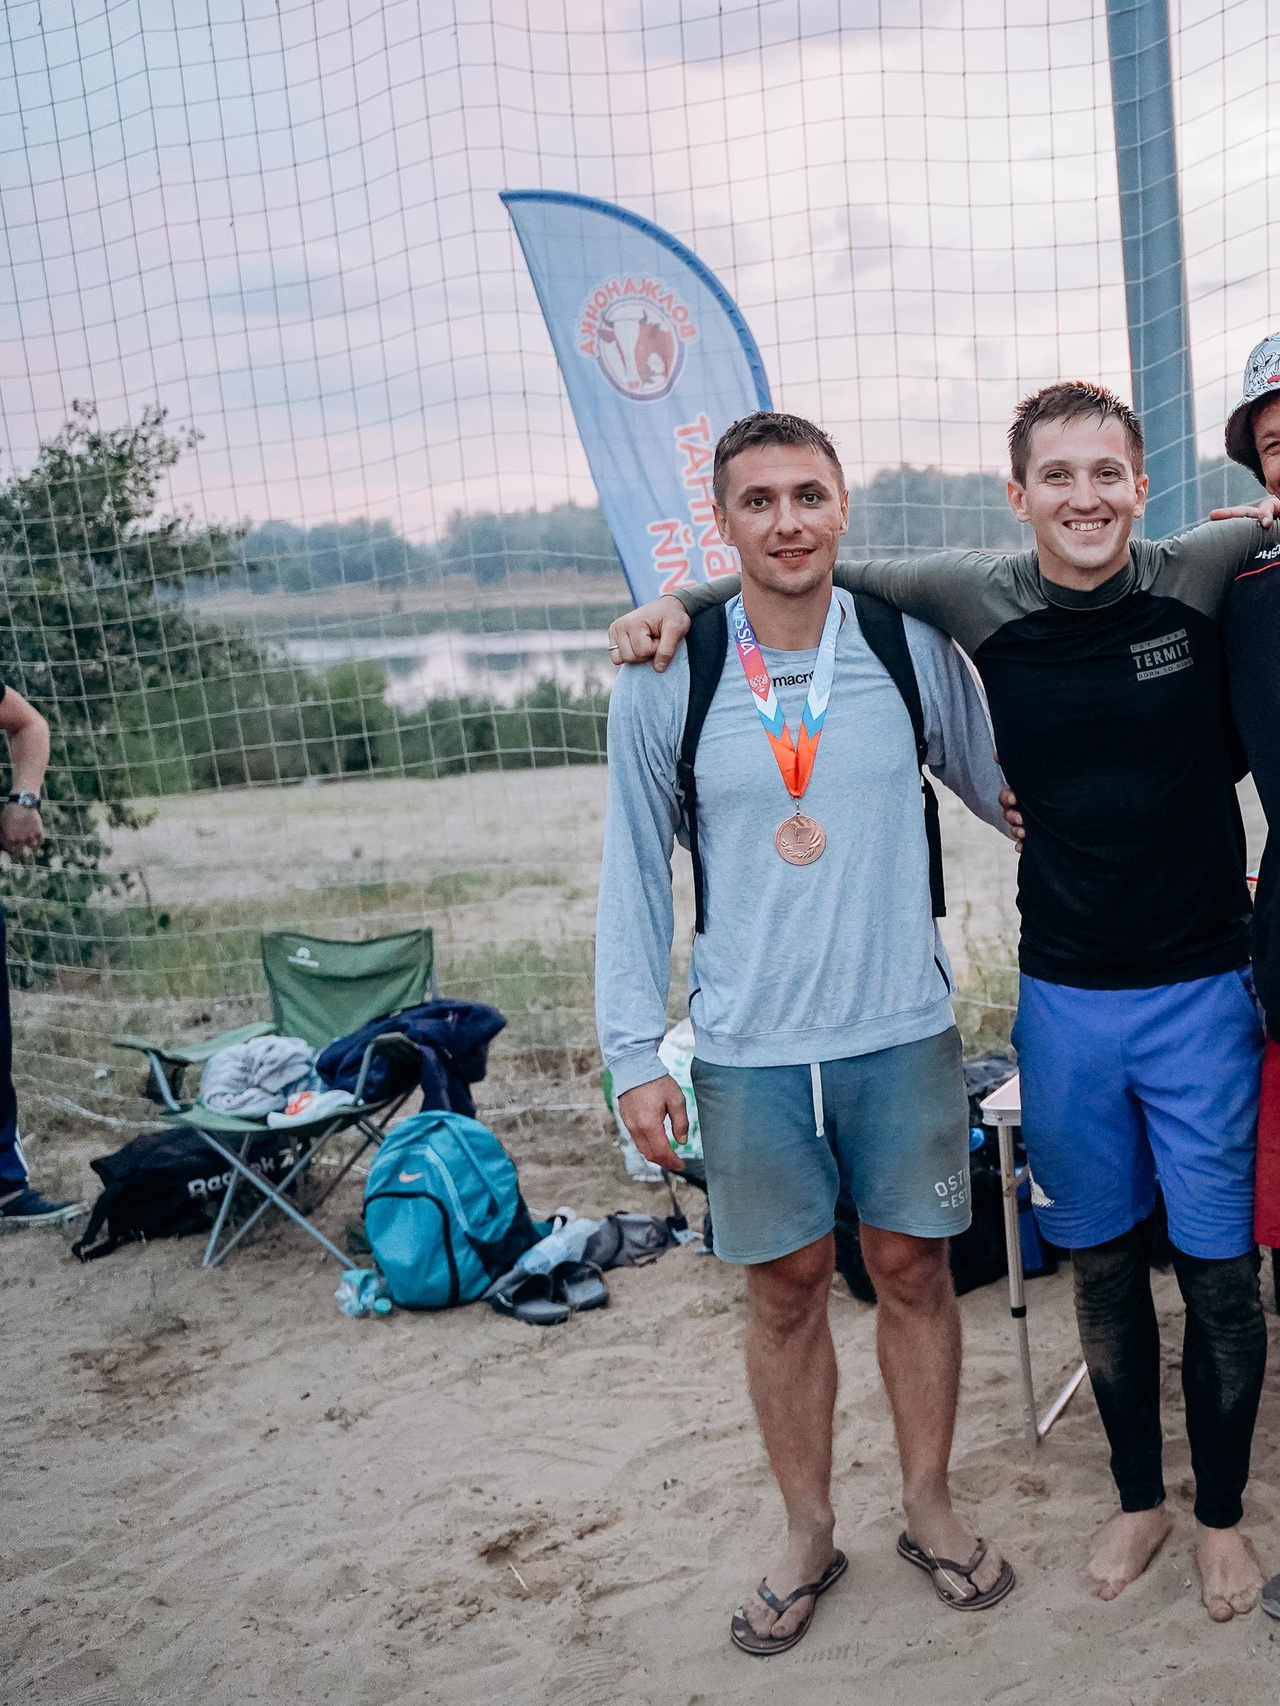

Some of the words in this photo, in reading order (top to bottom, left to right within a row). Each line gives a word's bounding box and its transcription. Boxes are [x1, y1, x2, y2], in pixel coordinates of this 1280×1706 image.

[1133, 640, 1189, 669] TERMIT
[1138, 669, 1160, 679] BORN
[187, 1155, 276, 1200] Reeok
